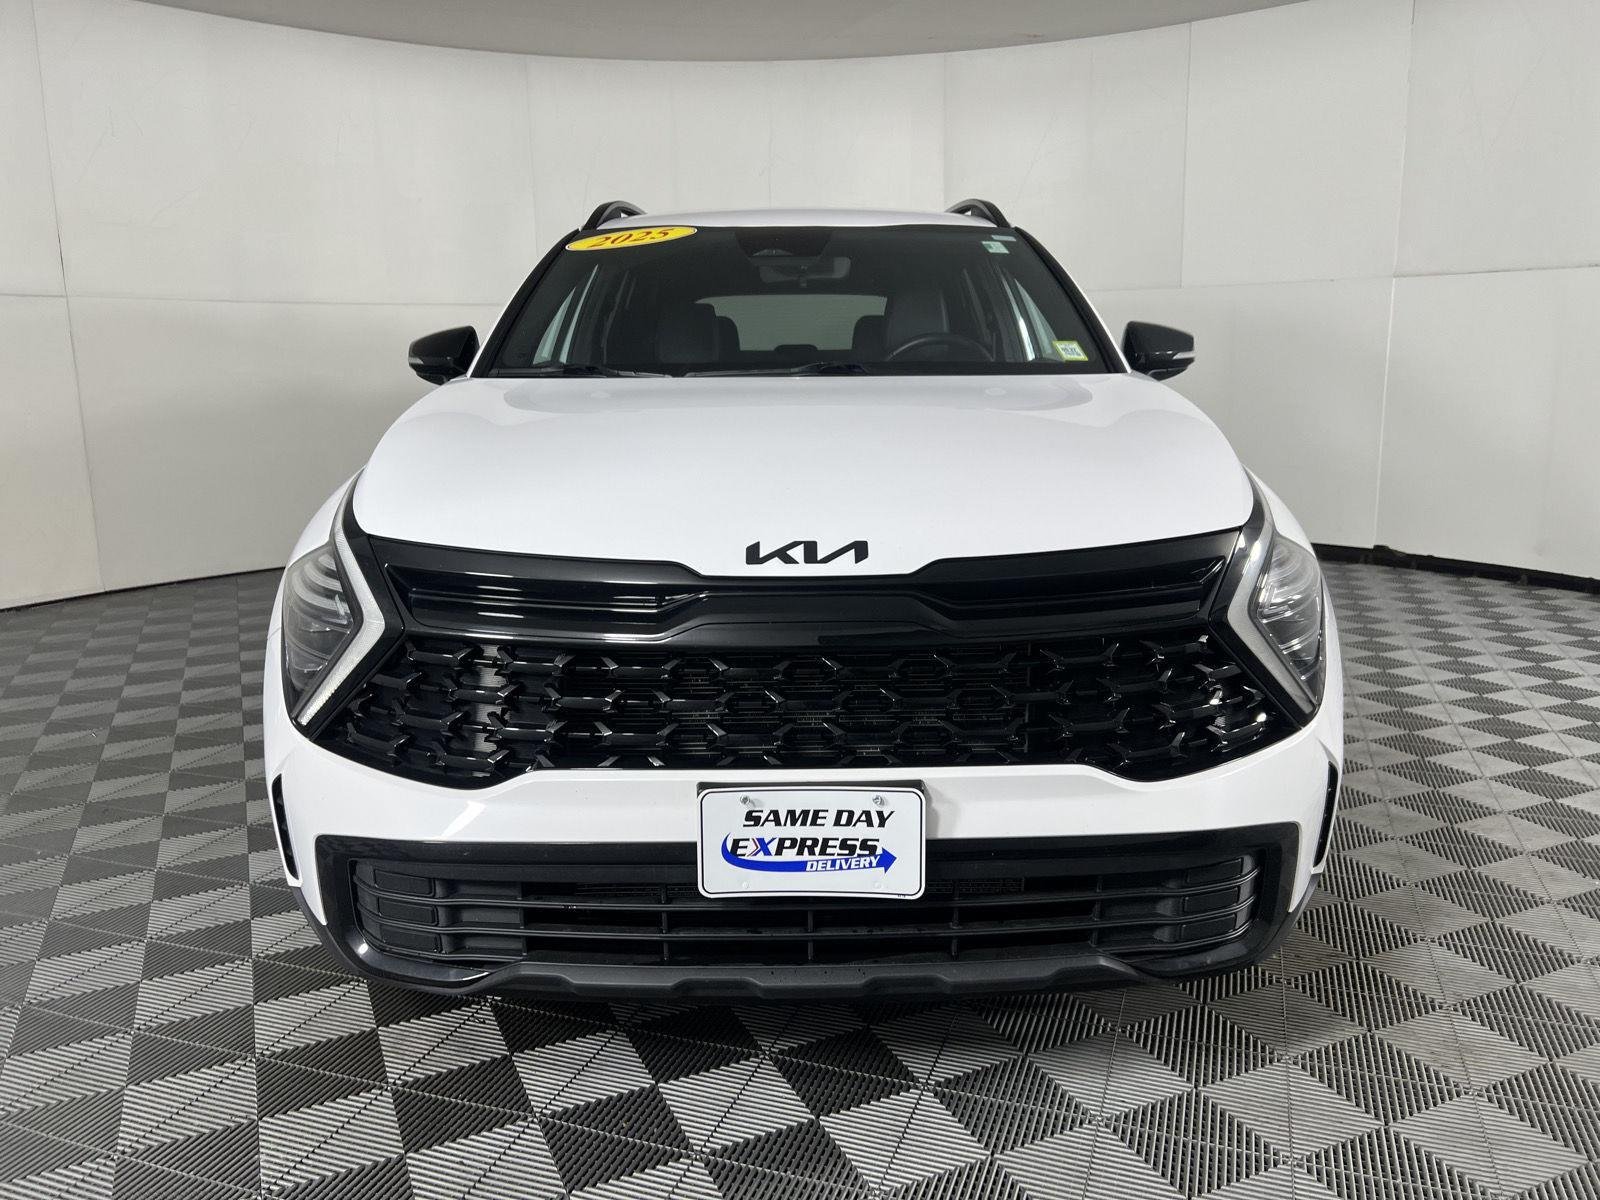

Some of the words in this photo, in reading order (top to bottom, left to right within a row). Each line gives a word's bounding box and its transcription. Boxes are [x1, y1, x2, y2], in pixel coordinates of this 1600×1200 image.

[587, 228, 675, 248] 2025
[746, 540, 868, 565] KIA
[743, 809, 828, 828] SAME
[833, 810, 895, 828] DAY
[730, 837, 880, 857] EXPRESS
[806, 856, 880, 872] DELIVERY
